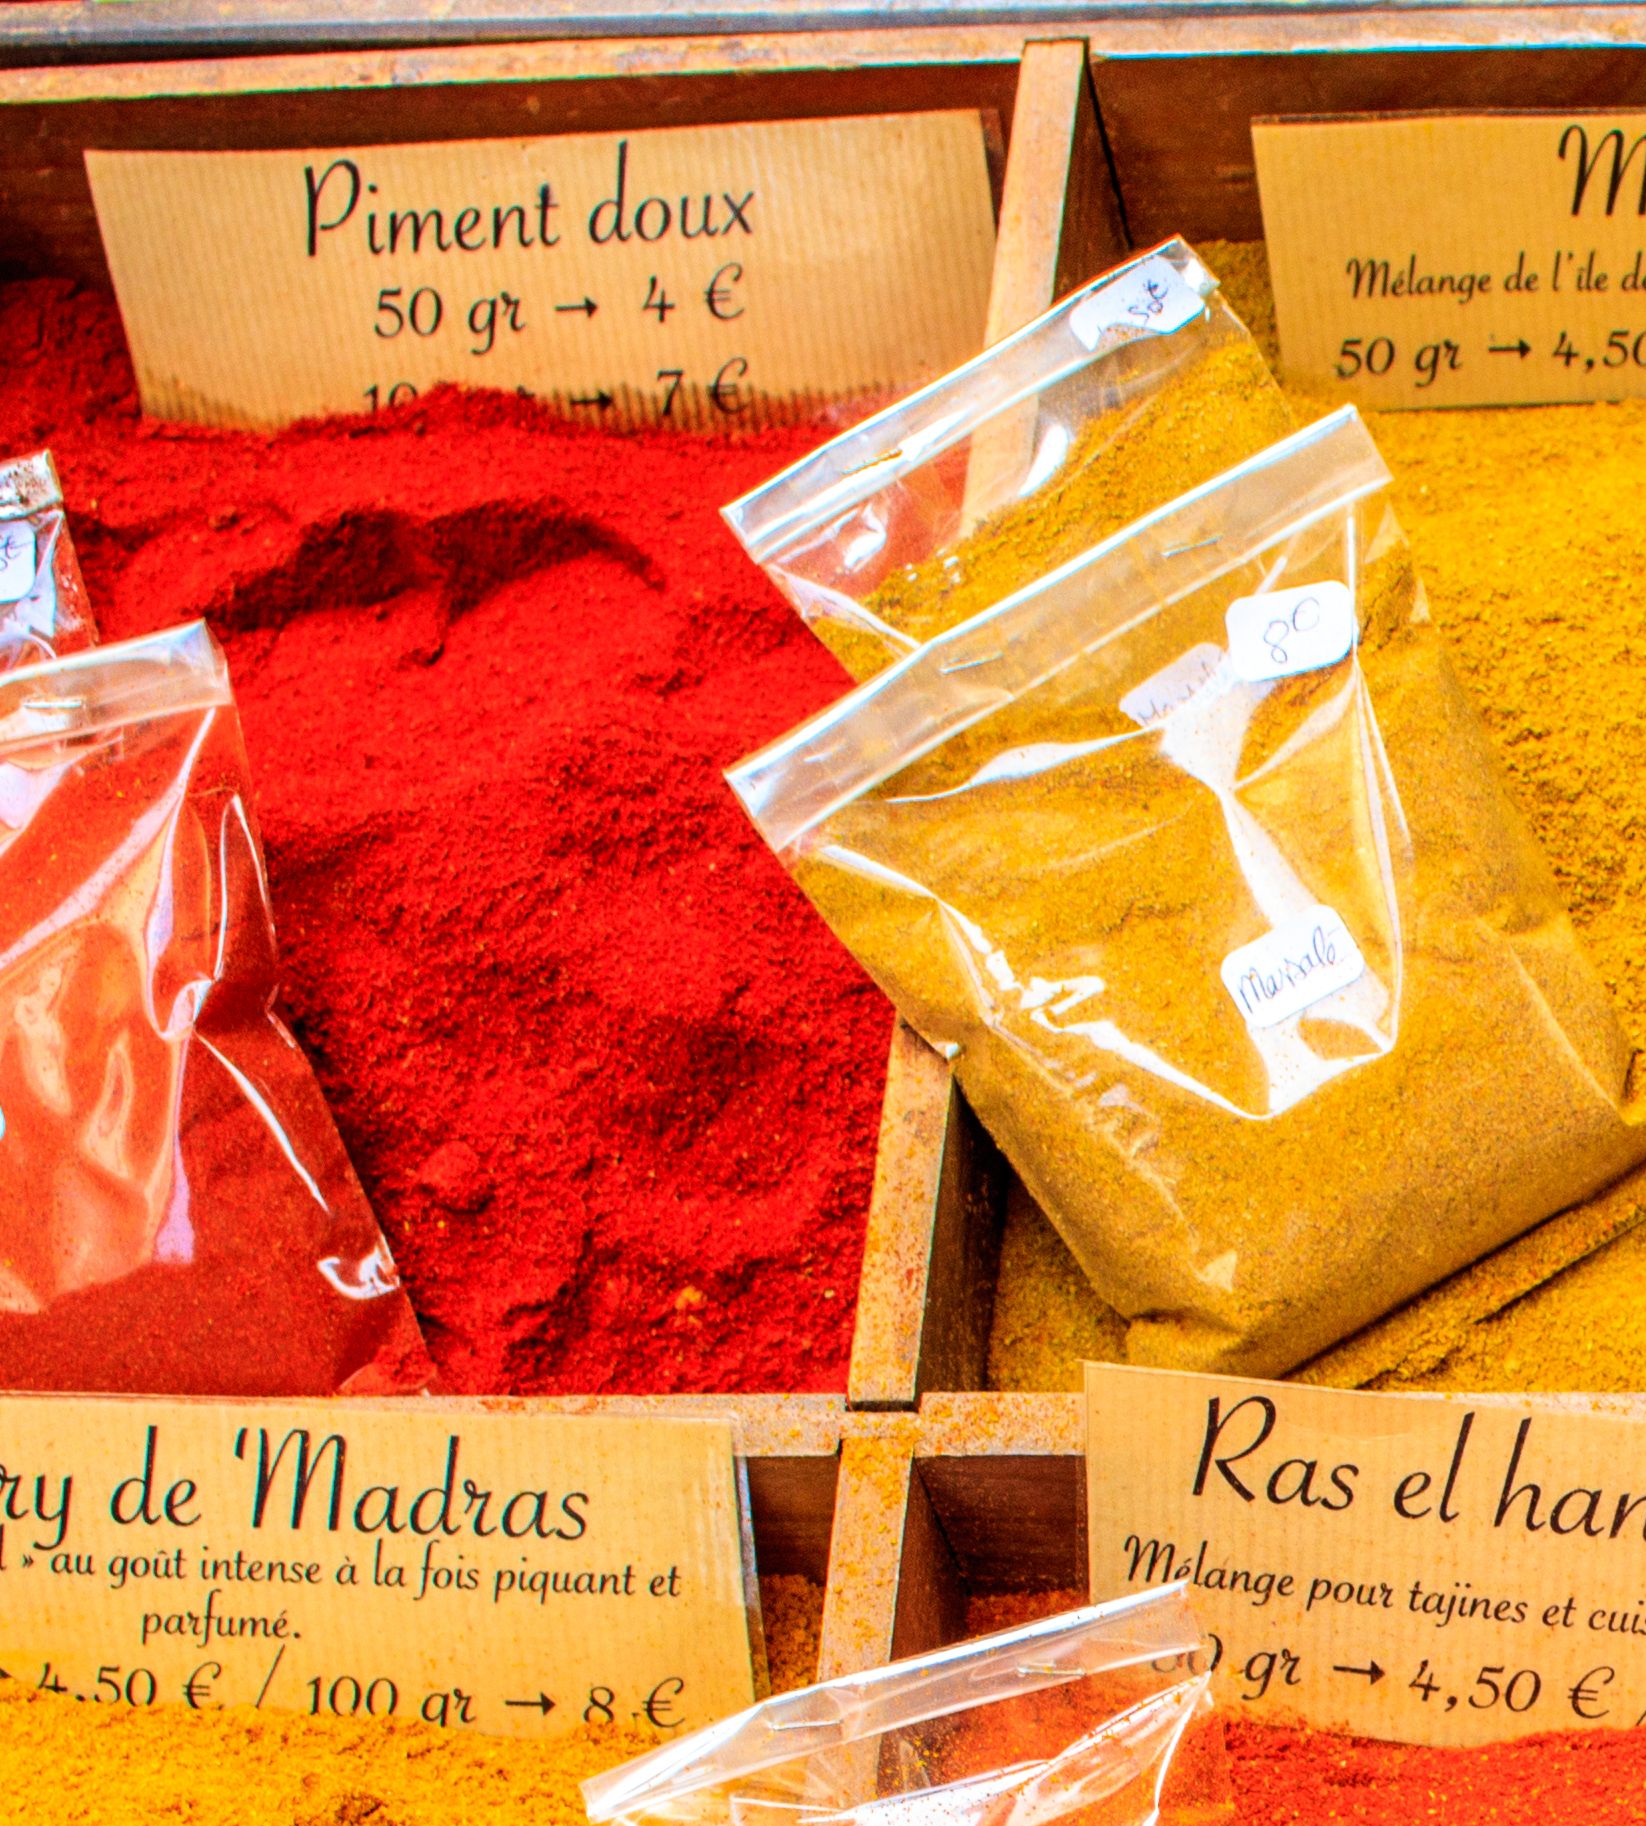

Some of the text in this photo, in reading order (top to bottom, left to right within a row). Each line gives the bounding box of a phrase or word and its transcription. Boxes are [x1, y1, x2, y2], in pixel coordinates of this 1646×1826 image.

[305, 141, 755, 257] Piment doux
[374, 262, 745, 353] 50 gr 4 €
[1347, 256, 1492, 303] Mélange
[1504, 250, 1537, 293] de
[657, 357, 748, 416] 7 €
[1336, 337, 1394, 379] 50
[1414, 337, 1463, 387] gr
[110, 1426, 200, 1526] de
[1192, 1395, 1357, 1511] Ras
[1392, 1412, 1463, 1524] el
[51, 1540, 681, 1604] au goût intense à la fois piquant et
[1125, 1535, 1294, 1603] Mélange
[1307, 1575, 1395, 1612] pour
[1407, 1582, 1529, 1630] tajines
[1542, 1596, 1575, 1628] et
[141, 1590, 302, 1648] parfumé.
[182, 1661, 223, 1710] €
[306, 1675, 400, 1716] 100
[583, 1686, 616, 1724] 8
[642, 1677, 686, 1728] €
[1241, 1648, 1301, 1700] gr
[1408, 1665, 1541, 1716] 4,50
[1569, 1665, 1615, 1721] €
